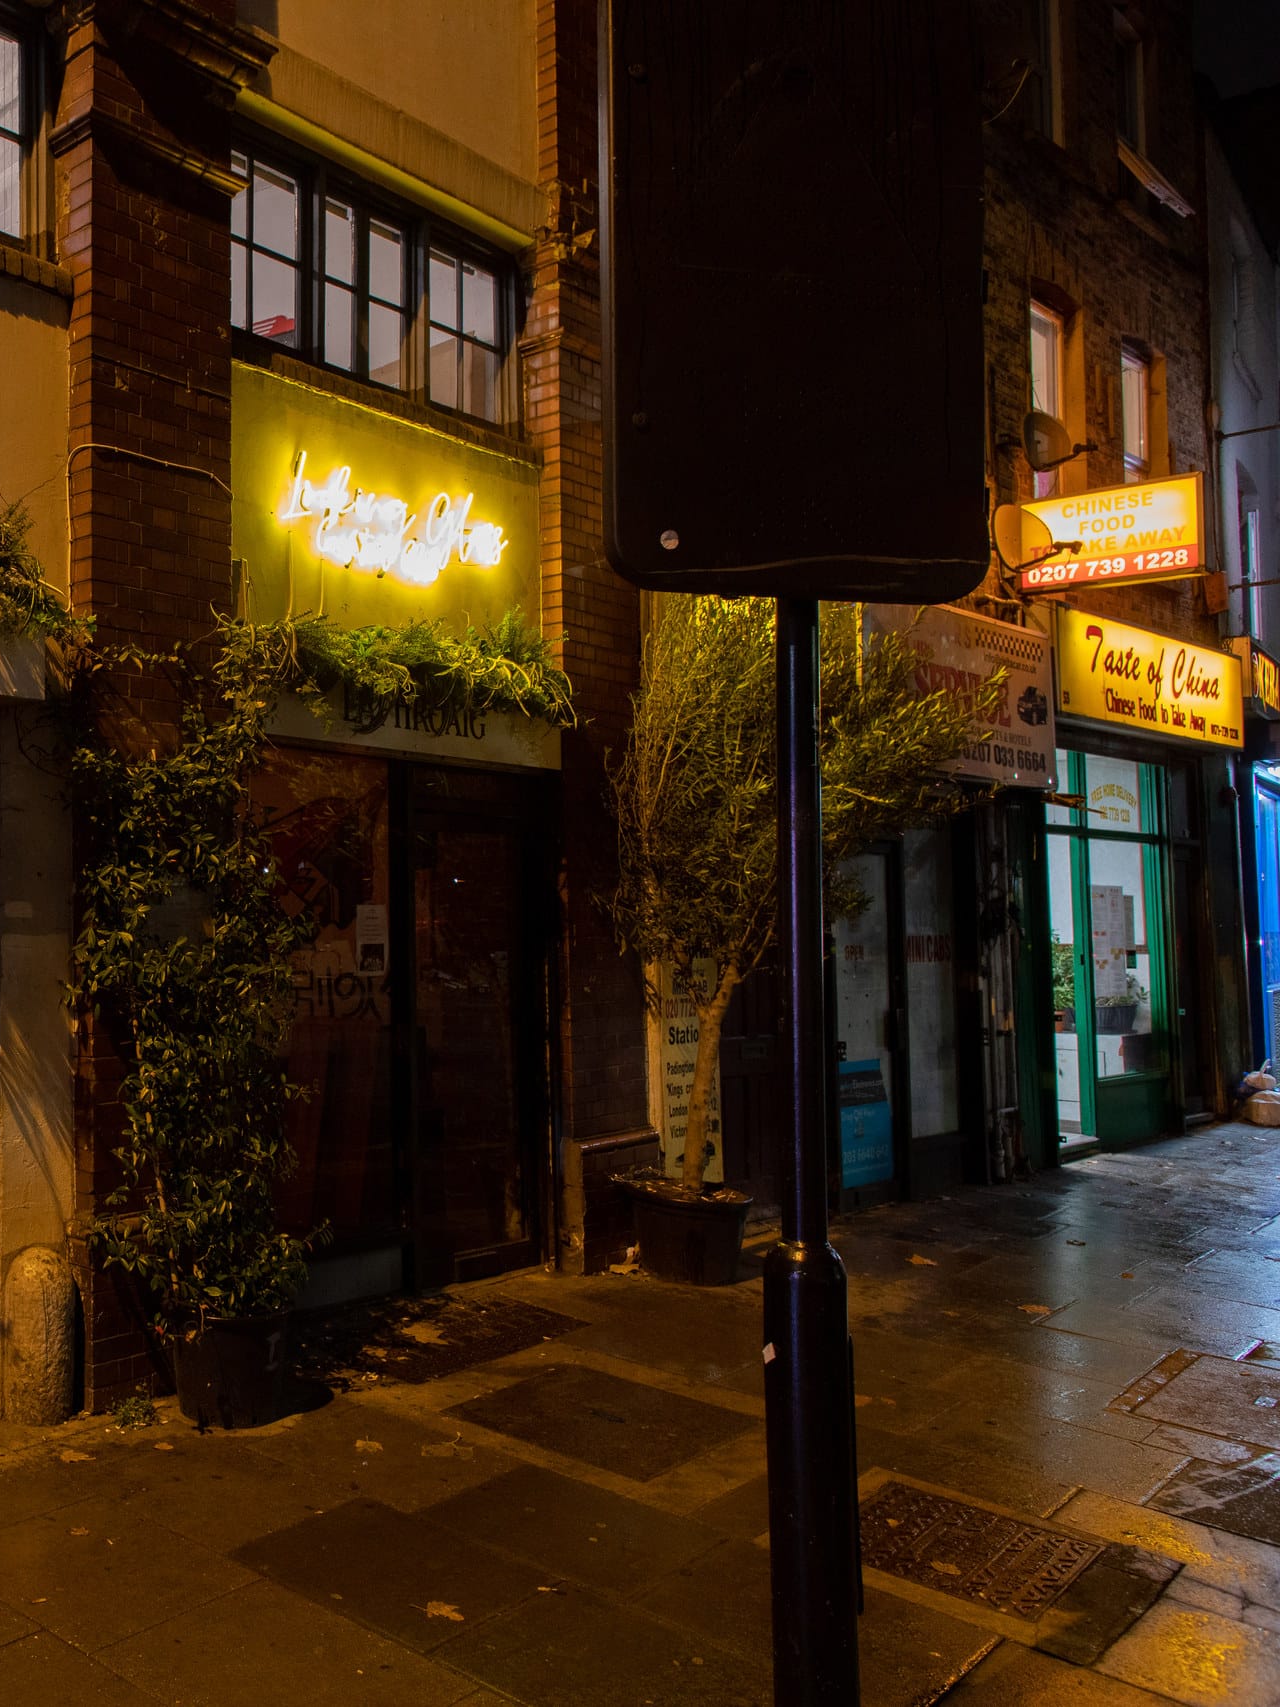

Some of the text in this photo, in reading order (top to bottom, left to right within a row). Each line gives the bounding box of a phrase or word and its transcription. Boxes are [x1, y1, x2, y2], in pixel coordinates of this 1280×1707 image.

[1062, 492, 1153, 519] CHINESE
[1079, 514, 1136, 536] FOOD
[1076, 535, 1117, 555] AKE
[1124, 526, 1187, 549] AWAY
[1028, 549, 1189, 584] 0207 739 1228
[1086, 625, 1220, 700] Taste of China
[1105, 687, 1206, 738] Chinese Food to Take Away
[993, 744, 1015, 768] 033
[1017, 749, 1047, 773] 6664
[669, 1024, 699, 1045] Statio
[669, 1103, 688, 1118] London
